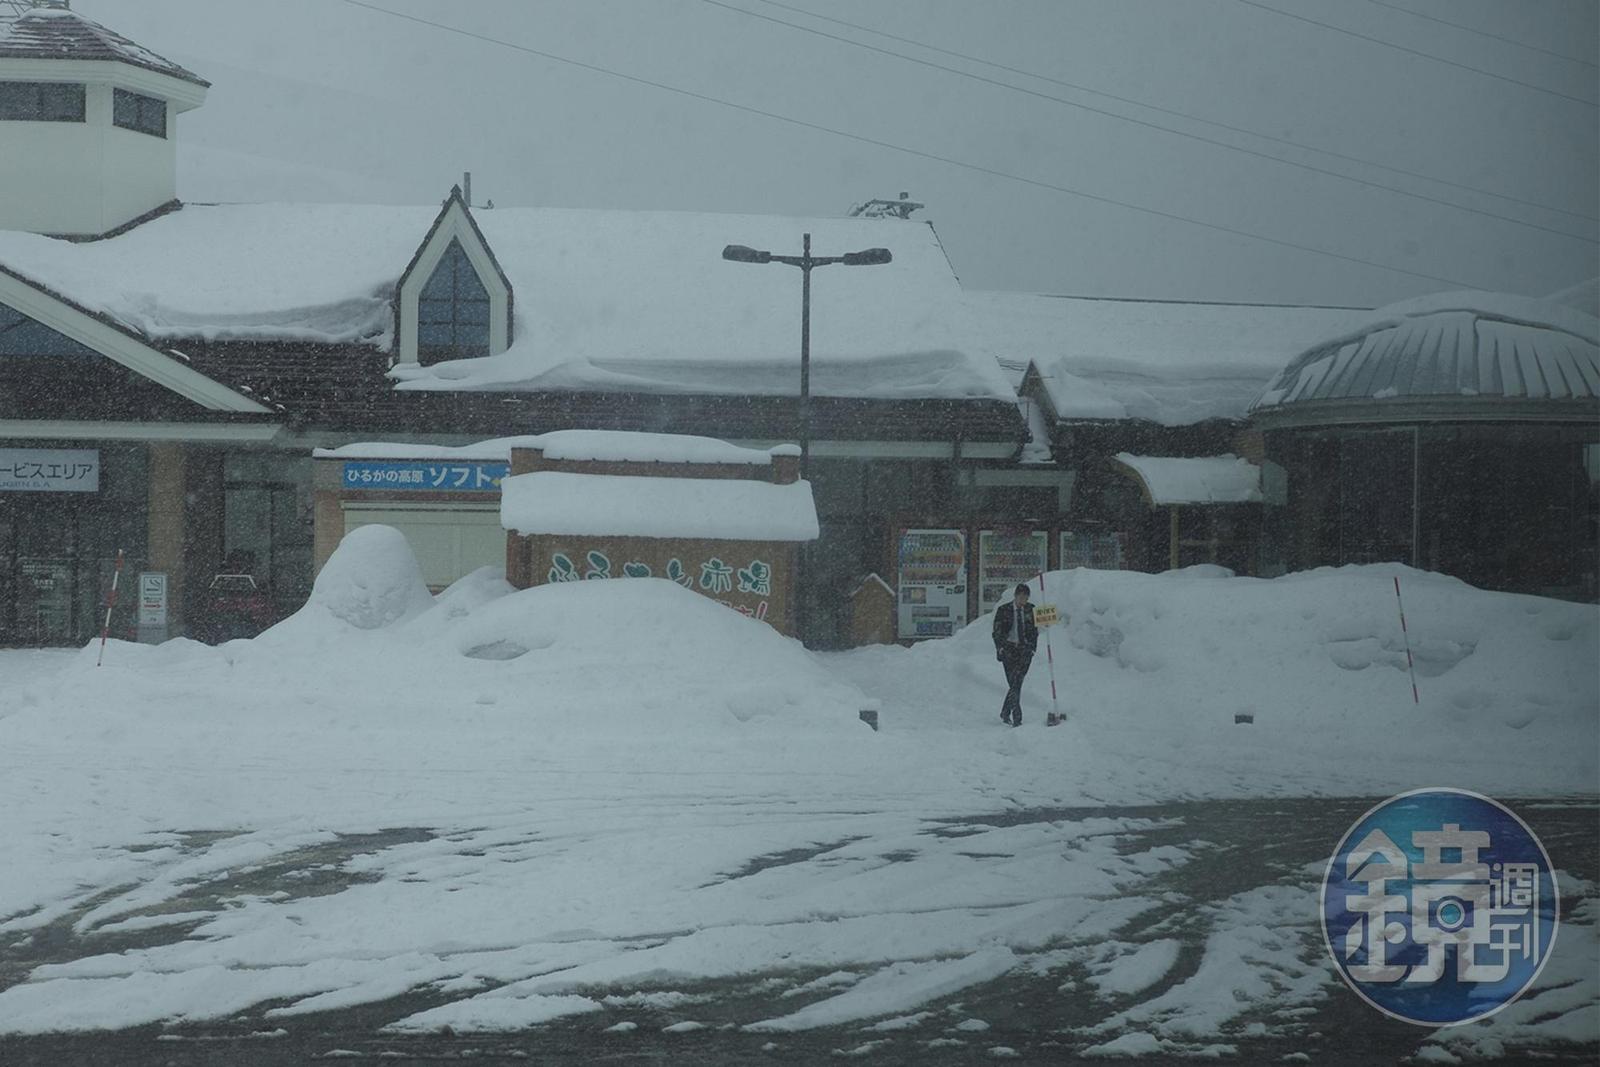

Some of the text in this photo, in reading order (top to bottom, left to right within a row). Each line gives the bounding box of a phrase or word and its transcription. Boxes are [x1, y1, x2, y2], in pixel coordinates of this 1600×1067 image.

[347, 469, 424, 483] ひるがの高原
